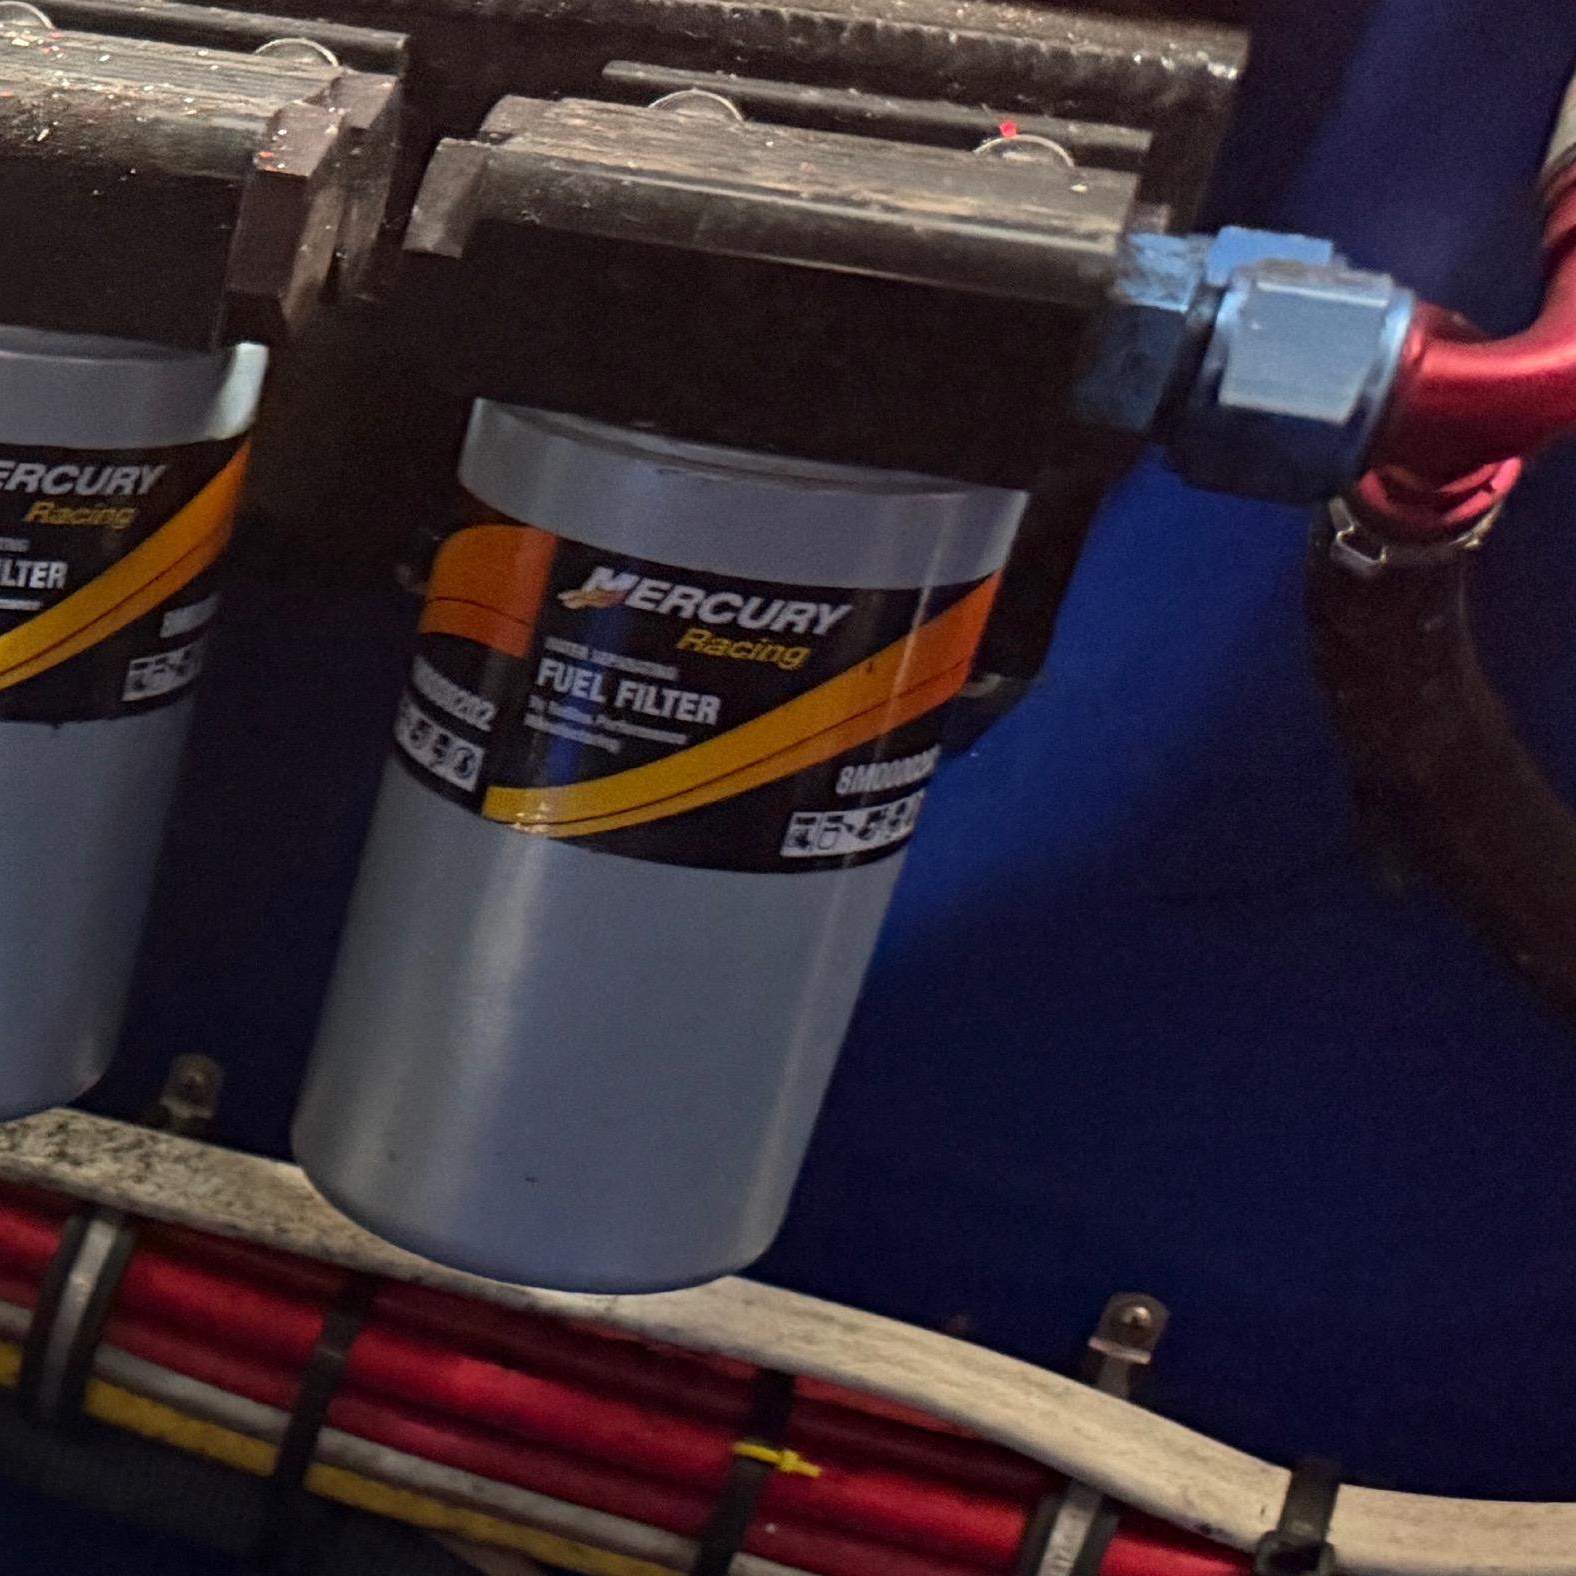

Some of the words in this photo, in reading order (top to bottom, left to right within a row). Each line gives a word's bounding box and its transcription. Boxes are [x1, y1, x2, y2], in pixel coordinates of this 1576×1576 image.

[22, 499, 140, 530] Racing
[569, 565, 853, 636] MERCURY
[673, 629, 813, 670] Racing
[535, 657, 607, 704] FUEL
[613, 678, 722, 727] FILTER
